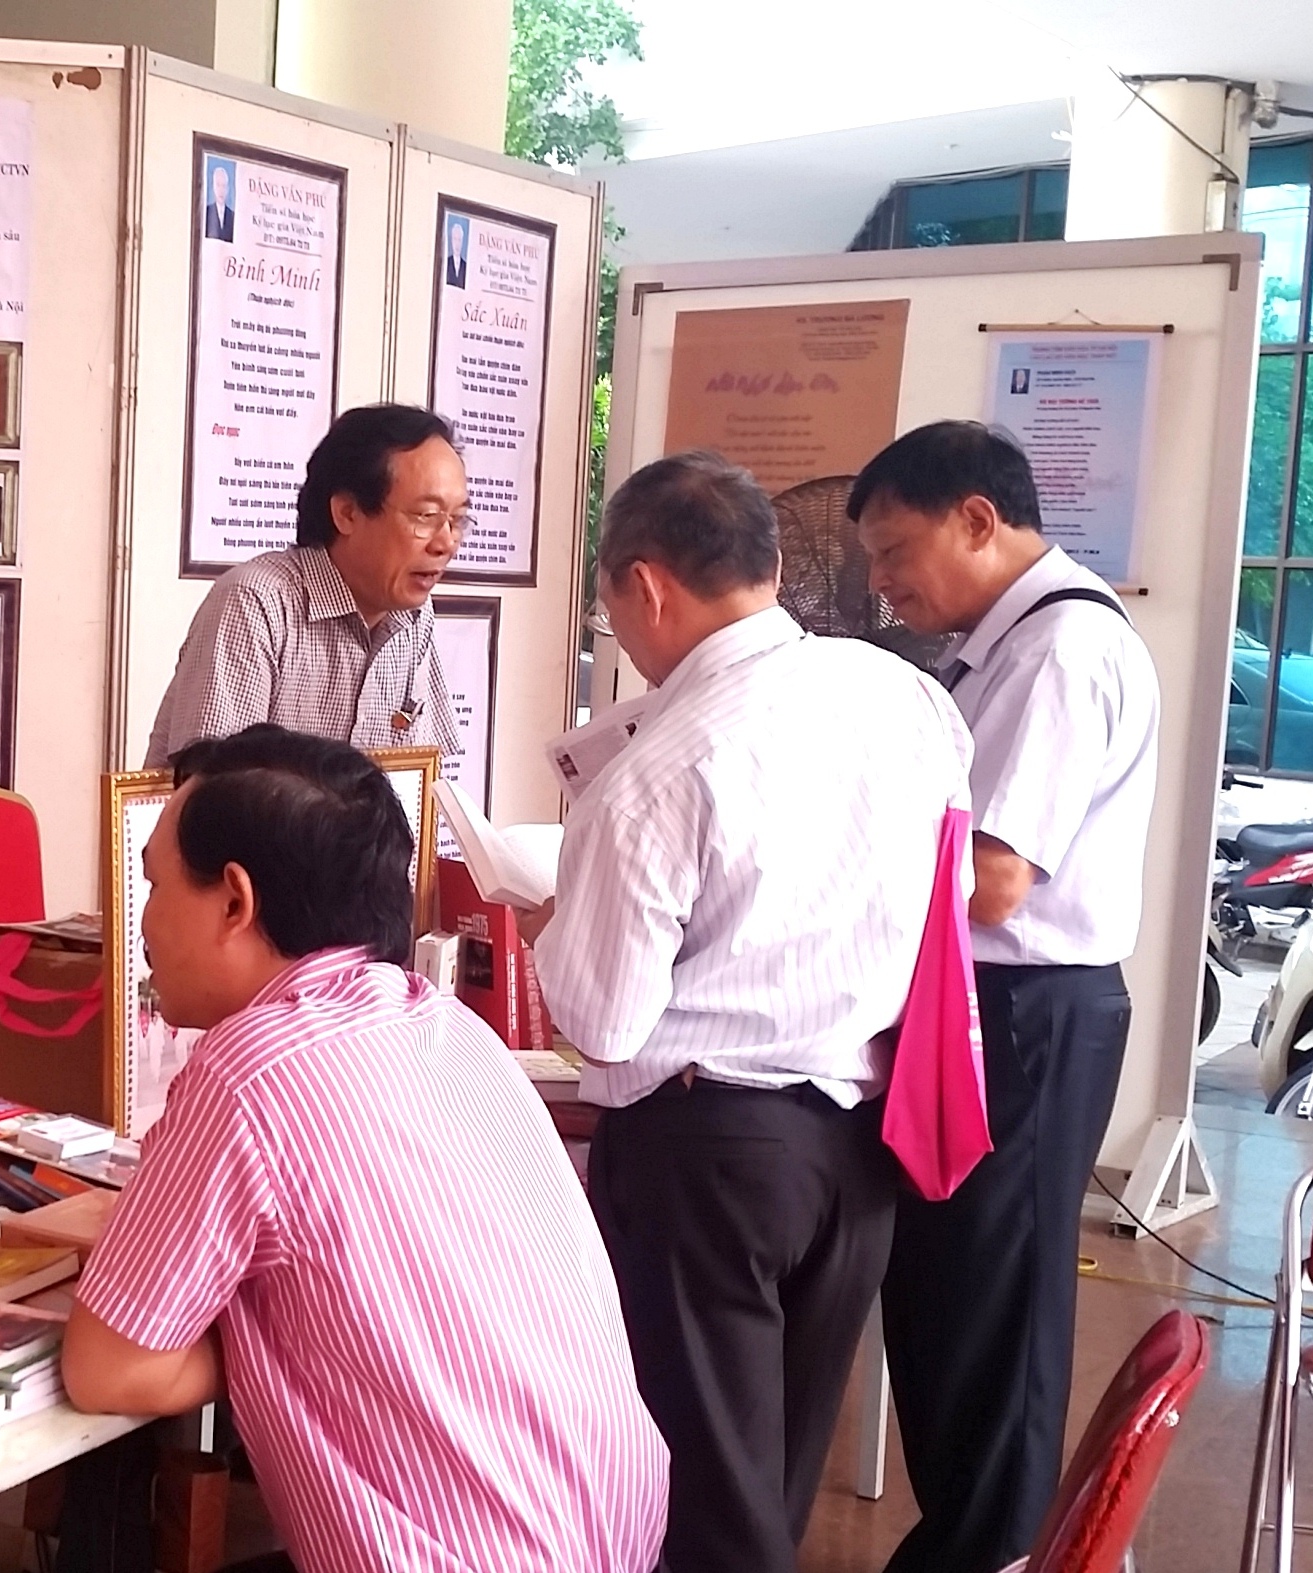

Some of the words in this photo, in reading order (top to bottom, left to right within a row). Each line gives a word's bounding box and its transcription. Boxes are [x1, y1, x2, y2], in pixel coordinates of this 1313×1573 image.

[224, 256, 265, 283] Bình
[270, 265, 321, 292] Minh
[461, 300, 487, 324] Sắc
[489, 307, 528, 332] Xuân
